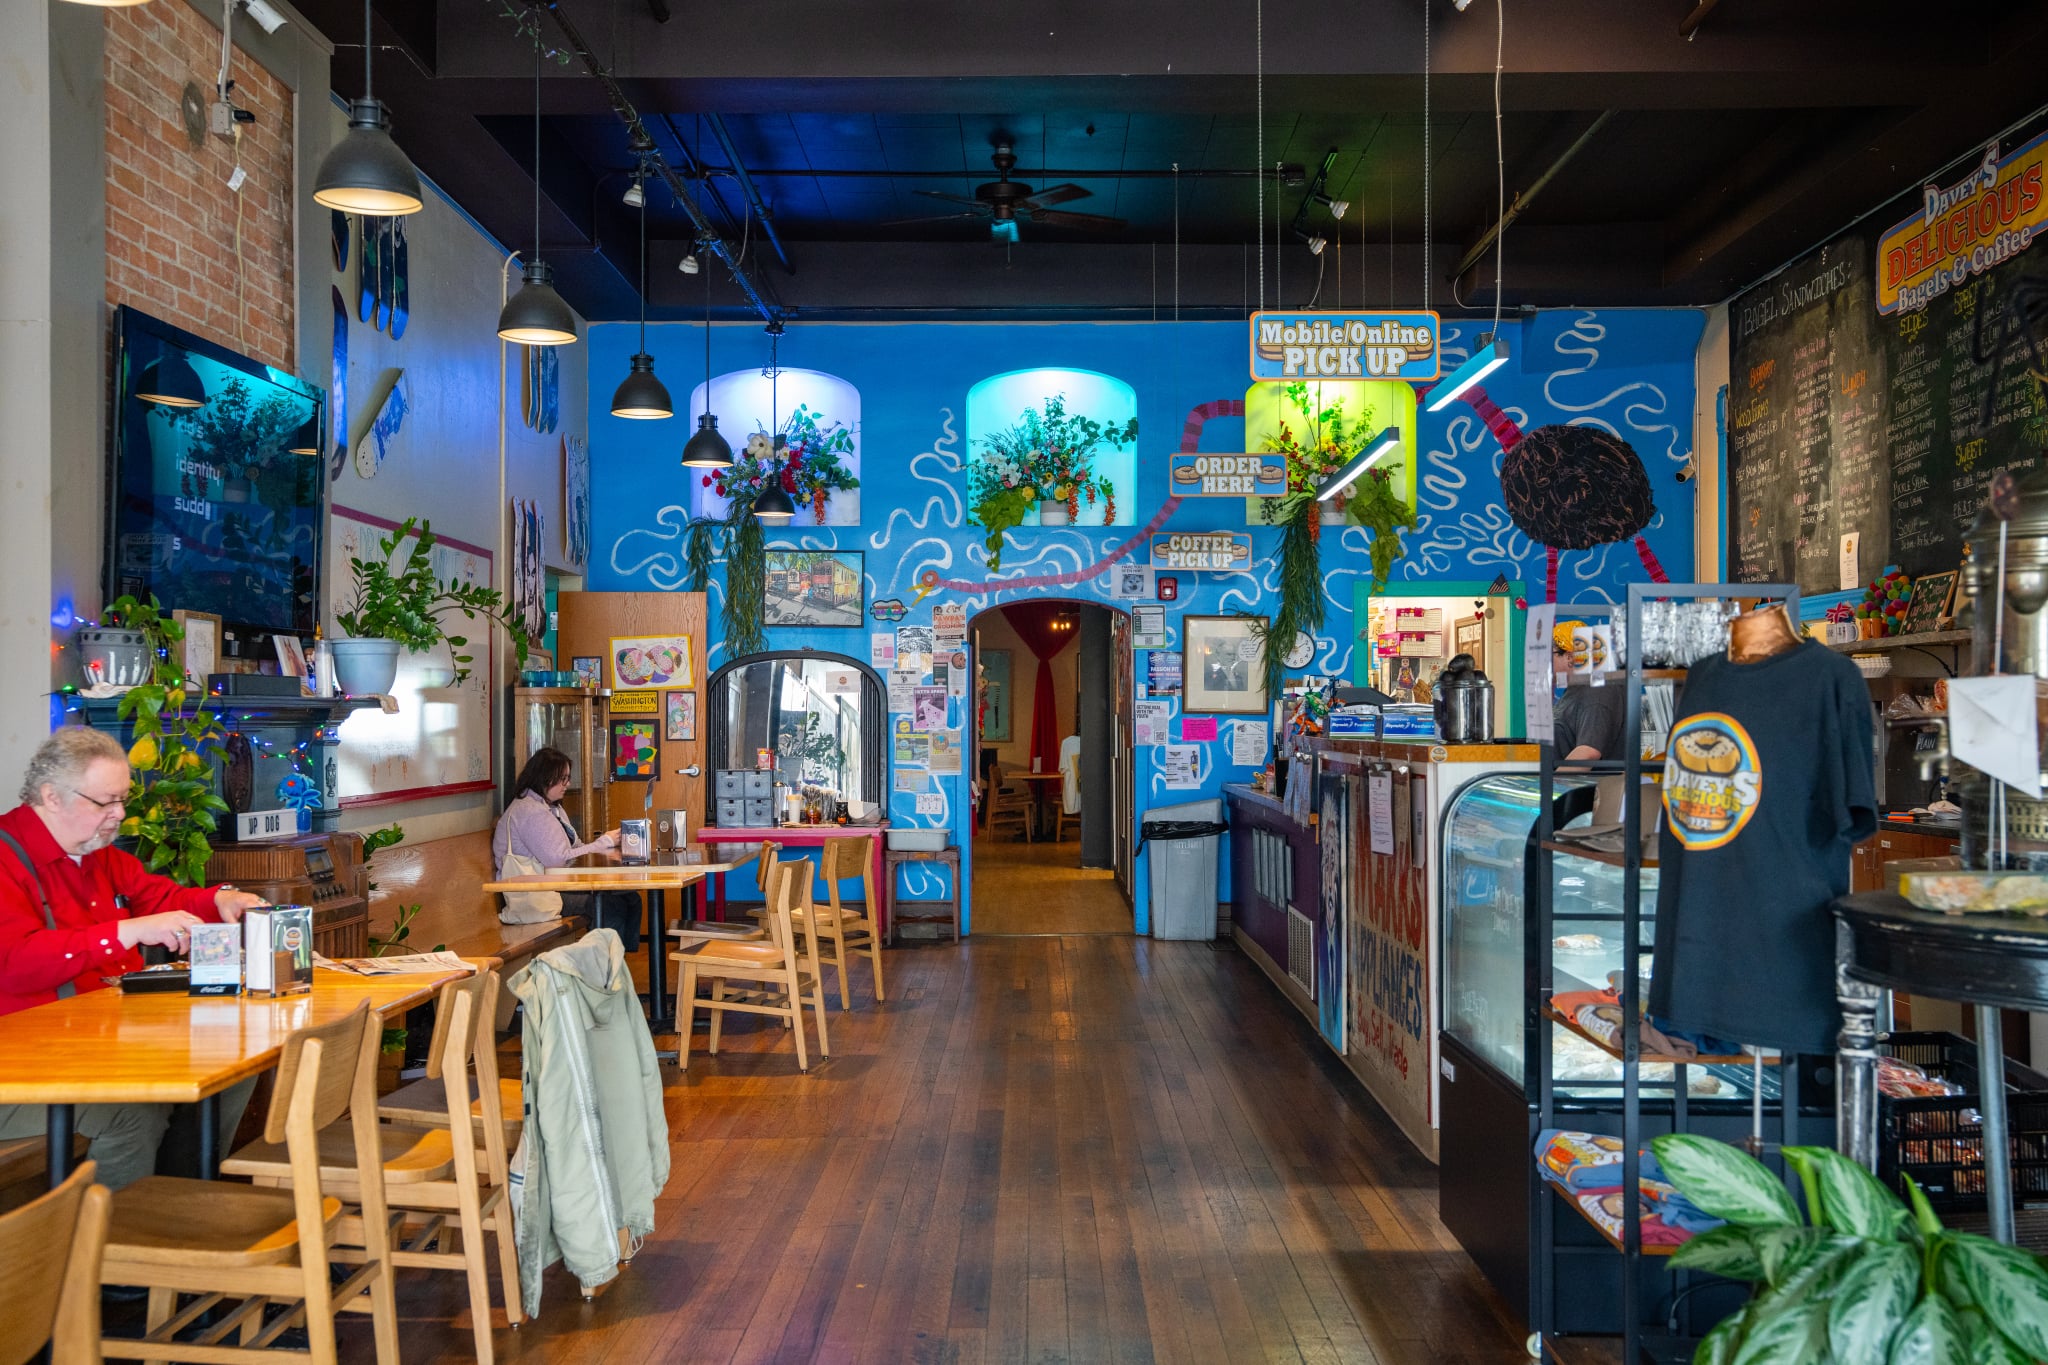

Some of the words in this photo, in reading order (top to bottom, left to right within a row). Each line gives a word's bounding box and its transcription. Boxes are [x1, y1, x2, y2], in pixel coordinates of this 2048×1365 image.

[1925, 148, 1998, 228] DAVEY'S
[1888, 162, 2043, 290] DELICIOUS
[1898, 268, 1948, 312] Bagels
[1953, 256, 1967, 282] &
[1972, 226, 2031, 271] Coffee
[1744, 296, 1778, 336] BAGEL
[1900, 309, 1928, 337] SIDES
[1260, 321, 1430, 346] Mobile/Online
[1283, 346, 1361, 376] PICK
[1364, 346, 1408, 376] UP
[176, 452, 221, 487] identity
[1195, 456, 1262, 476] ORDER
[1202, 475, 1255, 494] HERE
[1169, 535, 1233, 552] COFFEE
[1168, 552, 1210, 569] PICK
[1212, 552, 1234, 570] UP
[1916, 735, 1937, 751] PLAIN
[266, 814, 280, 832] DOG
